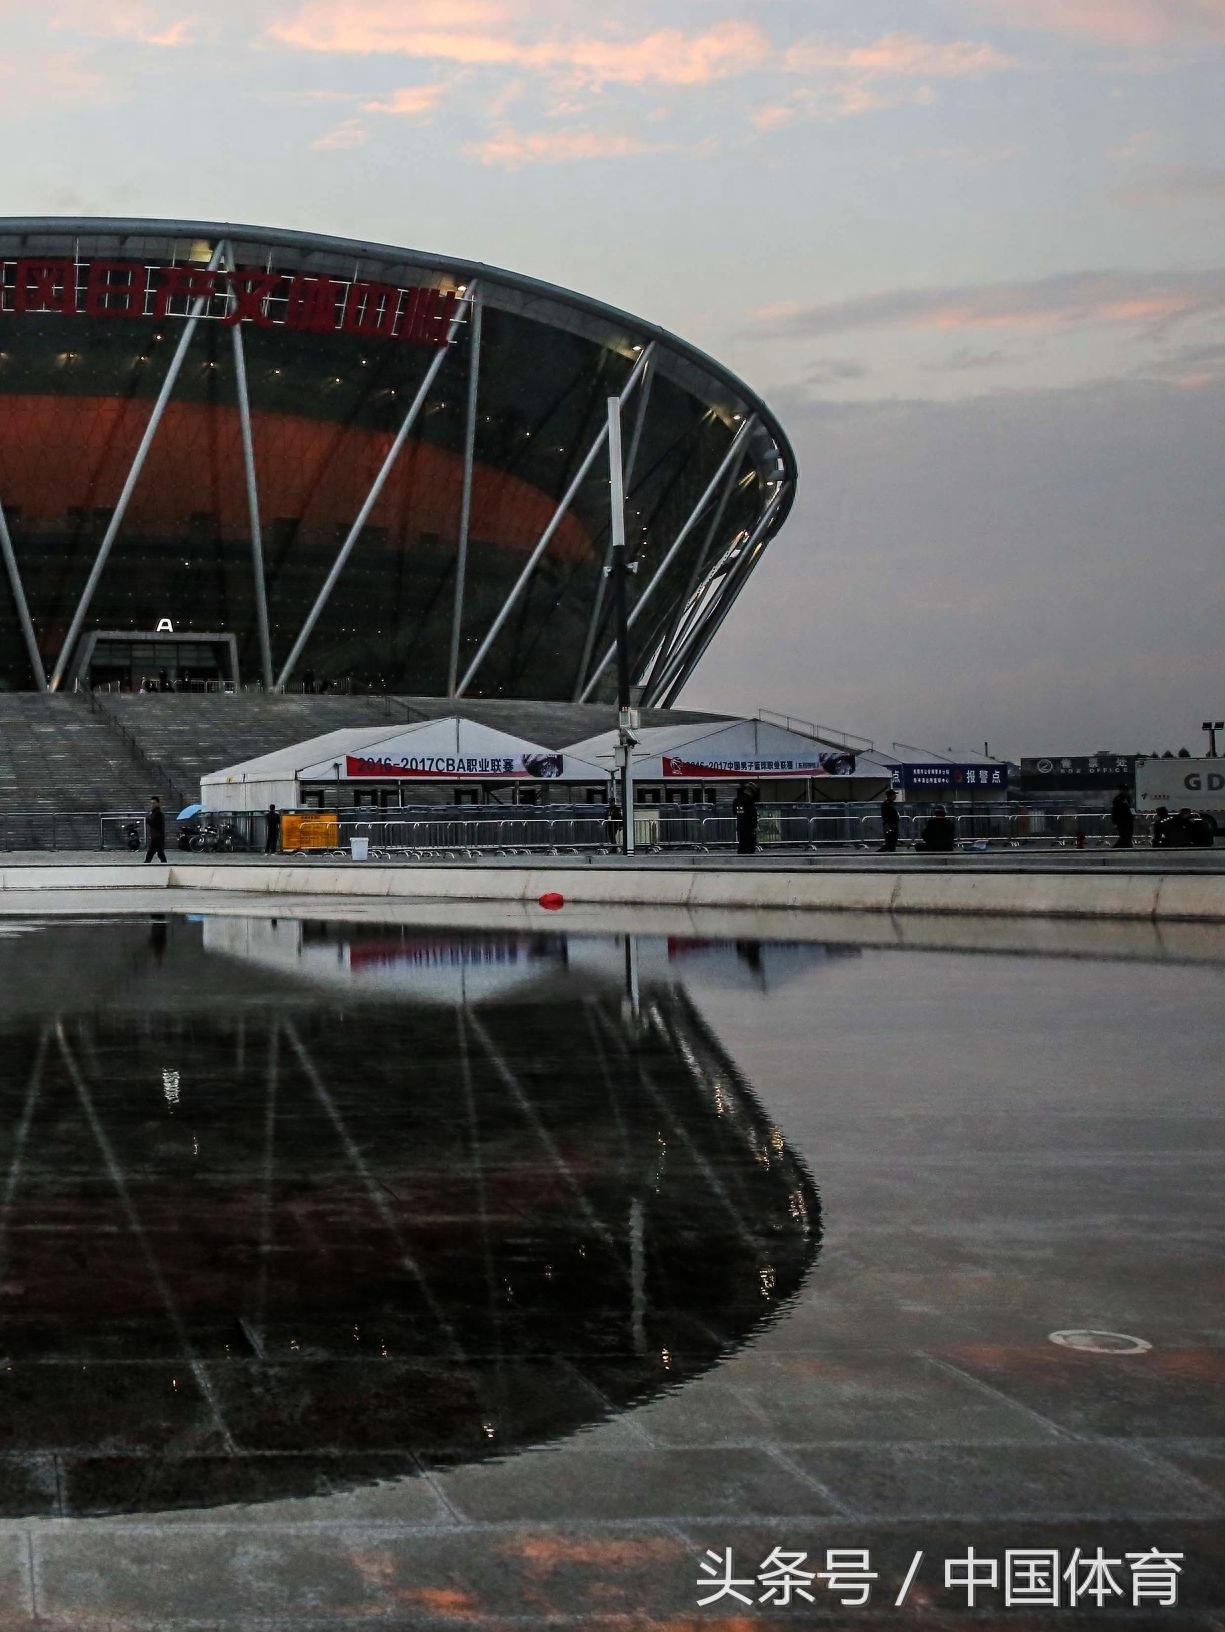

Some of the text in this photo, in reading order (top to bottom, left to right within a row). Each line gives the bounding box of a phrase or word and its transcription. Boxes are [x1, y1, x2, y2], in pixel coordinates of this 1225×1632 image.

[156, 618, 174, 632] A
[359, 757, 512, 773] 2016-2017CBA职业联赛
[966, 770, 1001, 783] 报警点
